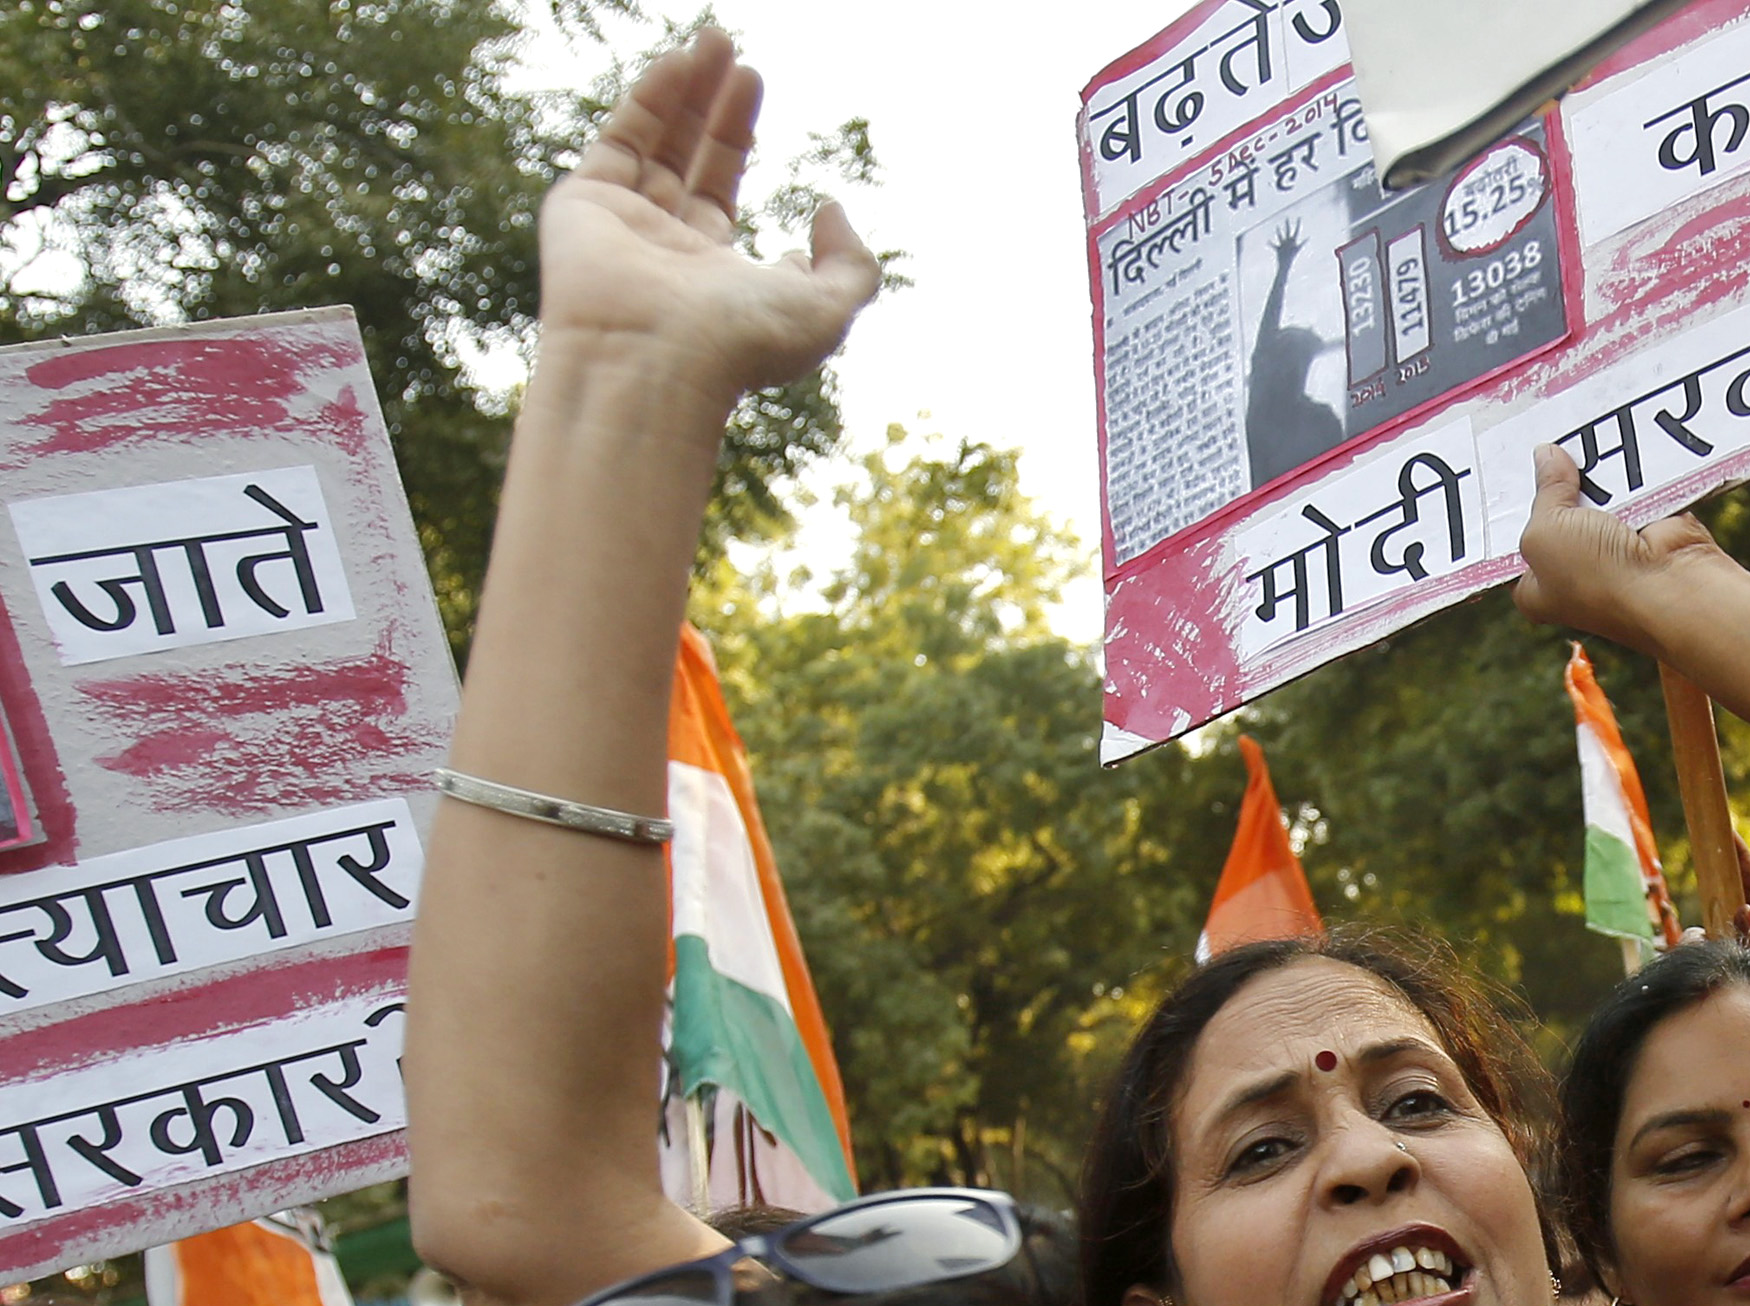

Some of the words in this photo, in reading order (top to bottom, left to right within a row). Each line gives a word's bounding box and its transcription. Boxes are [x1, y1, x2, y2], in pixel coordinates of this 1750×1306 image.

[1107, 186, 1216, 296] दिल्ली
[1222, 155, 1260, 210] में
[1267, 132, 1323, 191] हर
[1446, 174, 1551, 238] 15.25%
[1348, 256, 1376, 338] 13230
[1395, 257, 1425, 337] 11479
[1450, 239, 1543, 308] 13038
[29, 484, 325, 635] जाते
[1245, 451, 1472, 633] मोदी
[0, 1002, 407, 1219] सरकार
